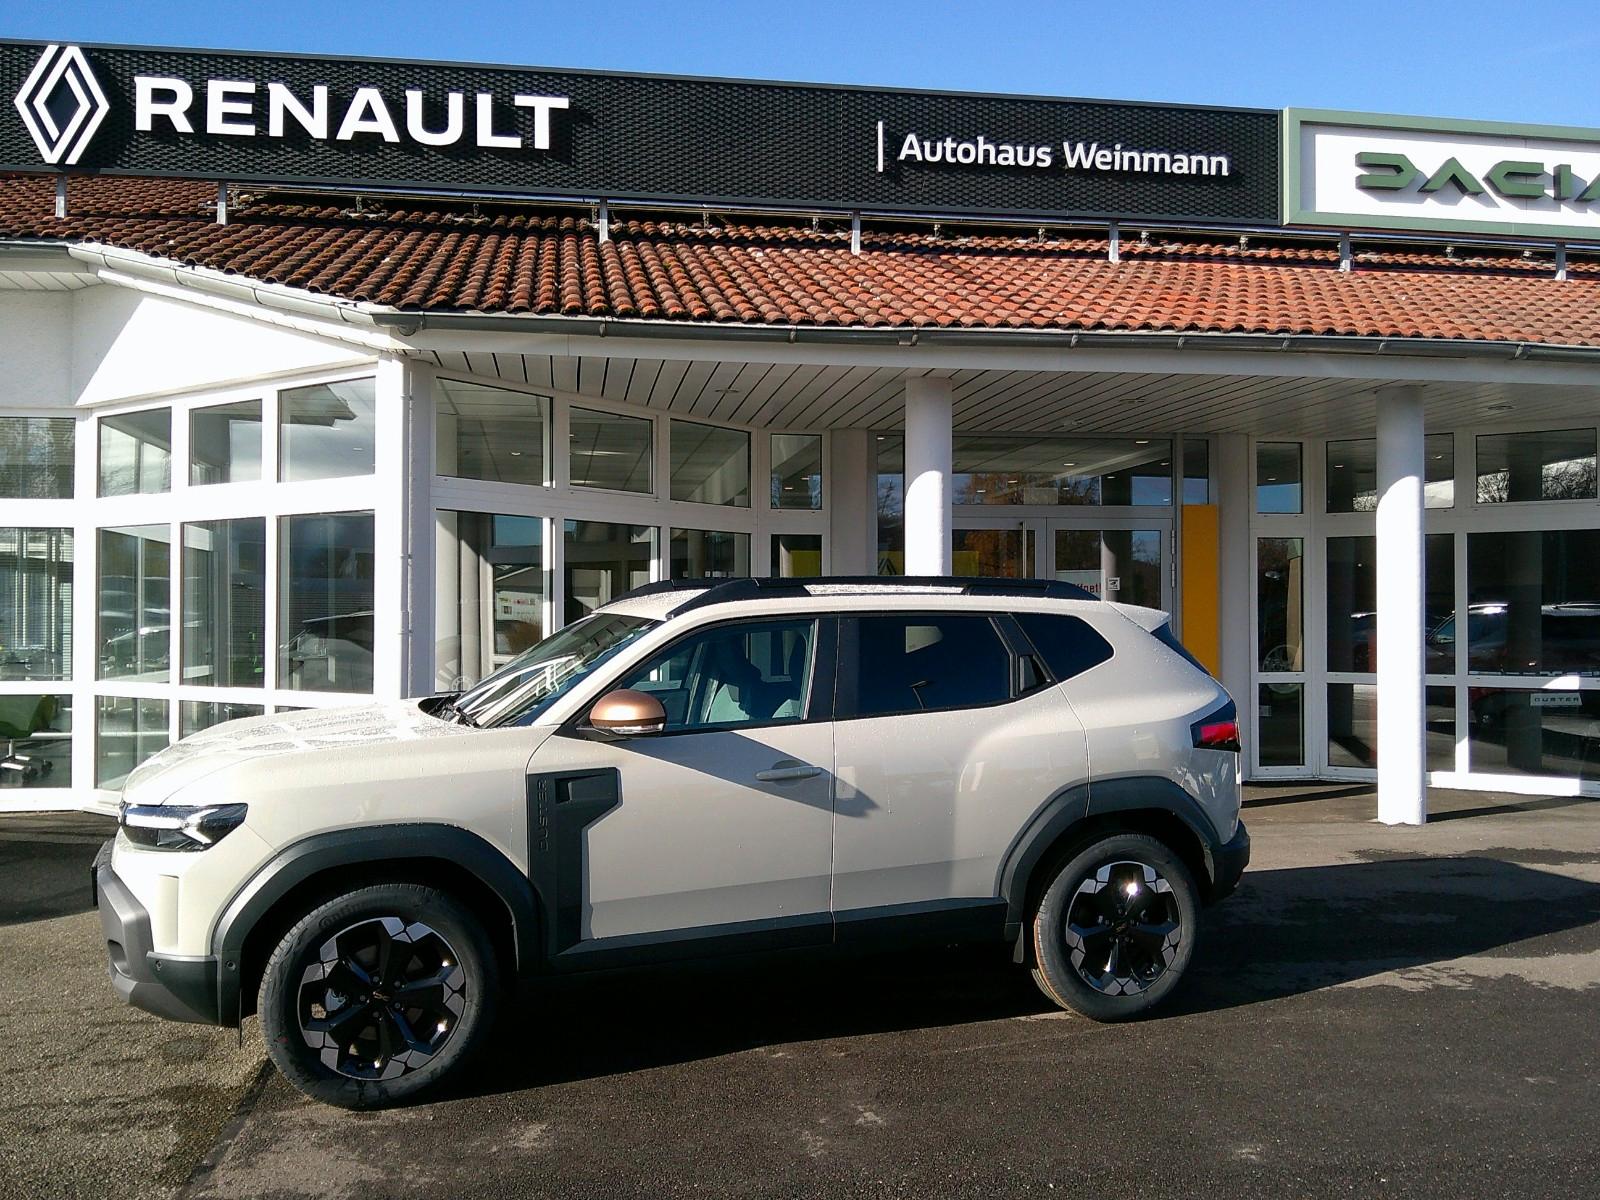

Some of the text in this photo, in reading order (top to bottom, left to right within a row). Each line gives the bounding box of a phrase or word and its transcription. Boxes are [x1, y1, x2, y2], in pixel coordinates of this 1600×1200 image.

[134, 75, 569, 150] RENAULT
[899, 133, 1229, 176] Autohaus Weinmann
[537, 777, 549, 851] DUSTER
